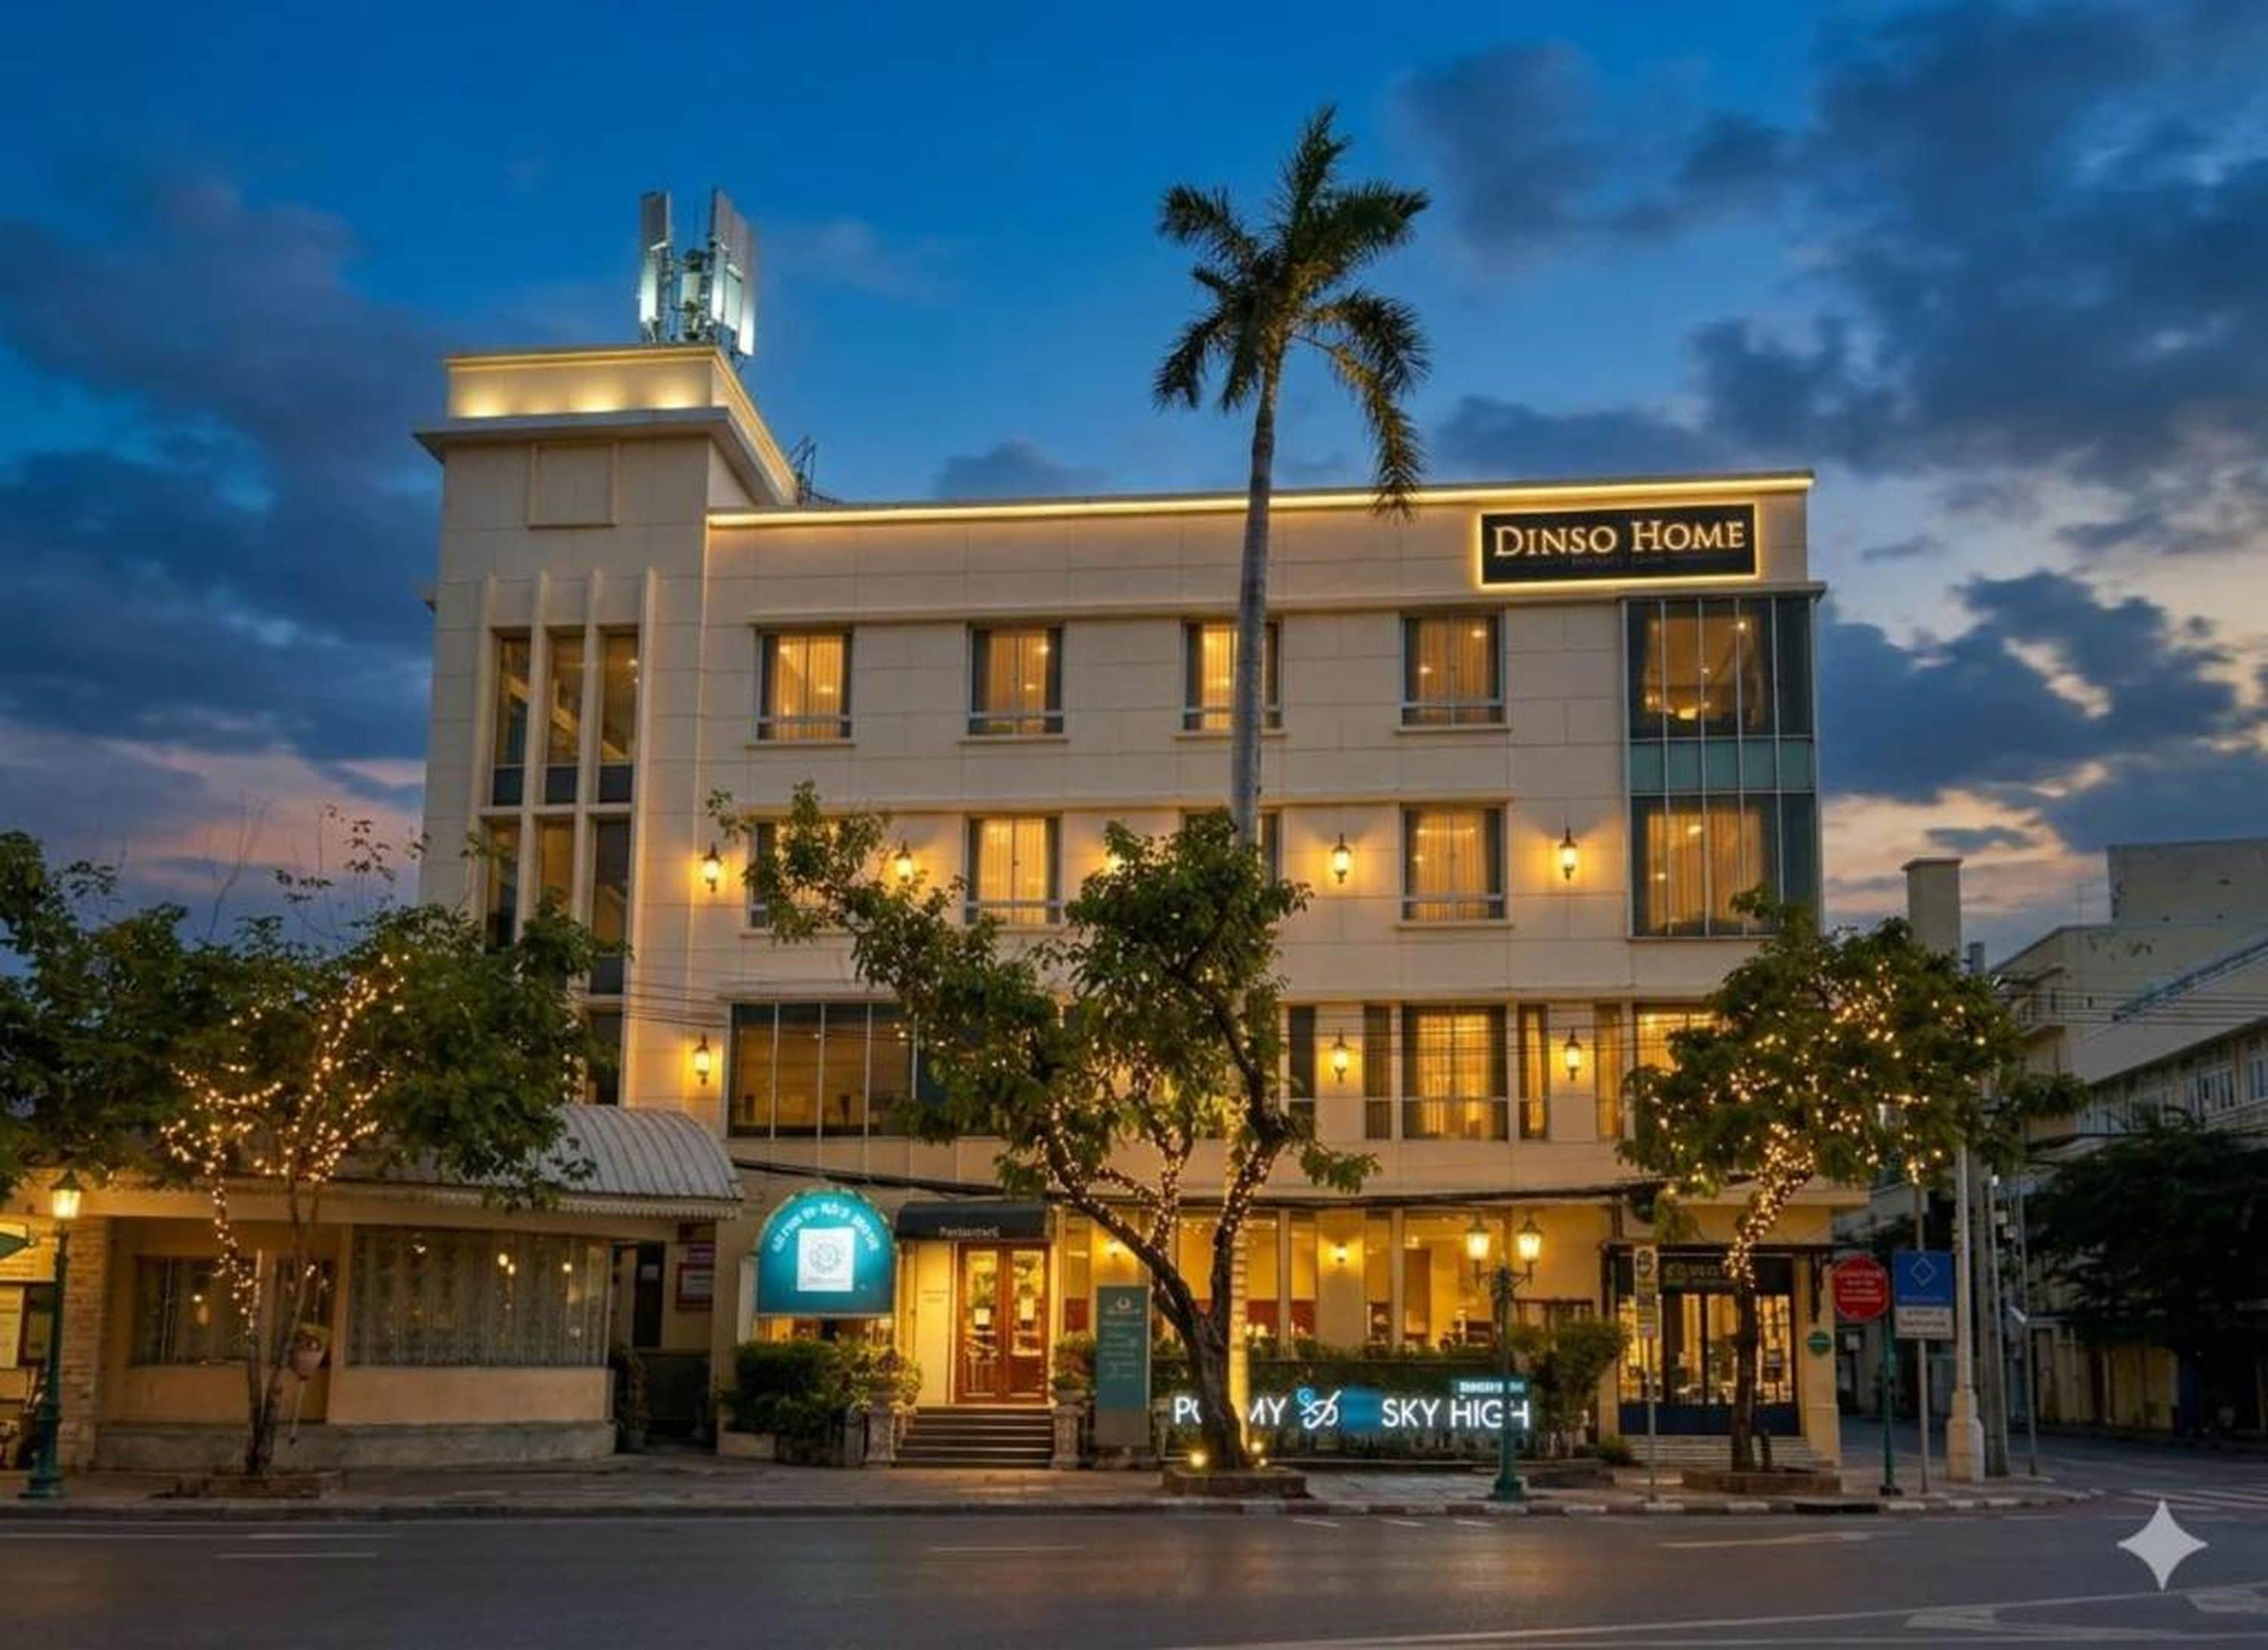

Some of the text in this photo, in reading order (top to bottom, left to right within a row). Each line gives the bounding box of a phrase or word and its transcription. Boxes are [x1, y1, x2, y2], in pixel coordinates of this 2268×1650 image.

[1492, 520, 1746, 556] DINSO HOME
[1381, 1398, 1440, 1428] SKY
[1450, 1398, 1530, 1429] HIGH
